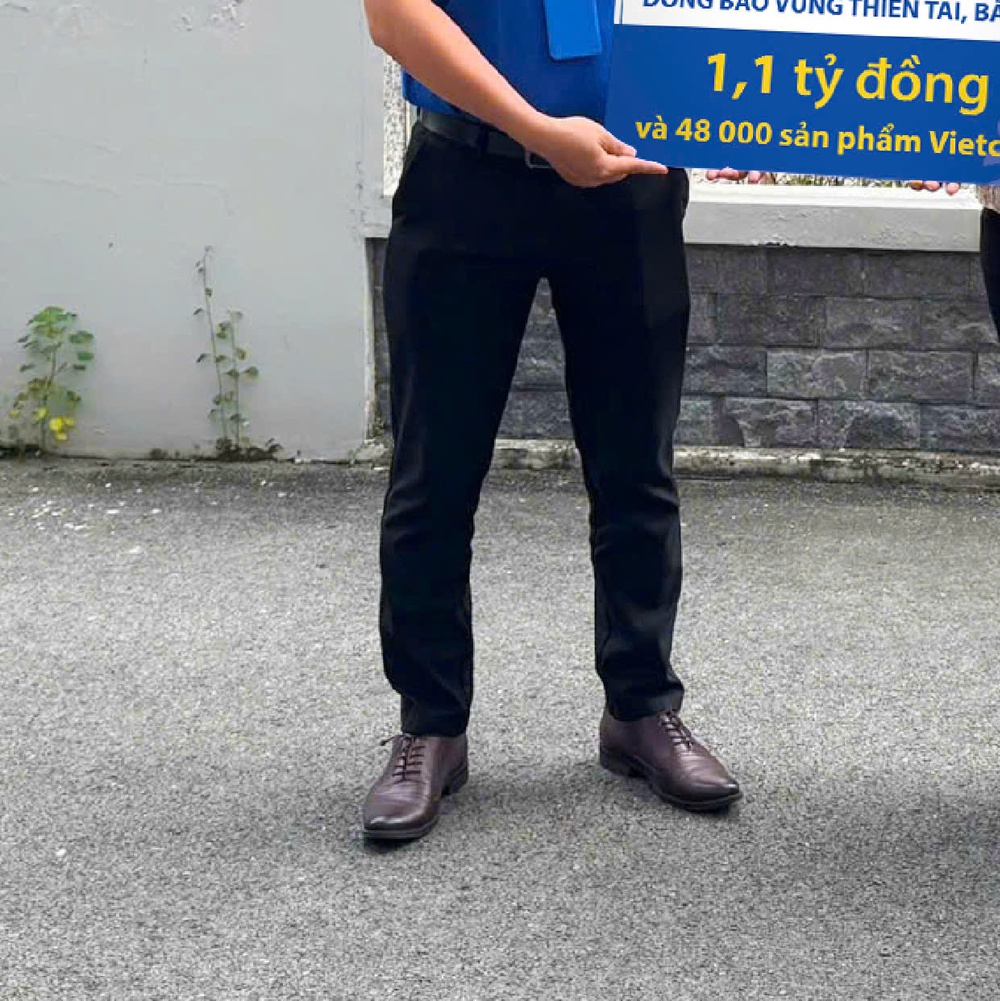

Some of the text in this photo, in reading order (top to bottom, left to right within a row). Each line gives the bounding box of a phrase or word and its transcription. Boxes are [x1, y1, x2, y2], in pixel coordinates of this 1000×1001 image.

[924, 0, 968, 24] TAI,
[707, 53, 990, 116] 1,1 tỷ đồng
[635, 115, 668, 141] và
[675, 118, 711, 143] 48
[719, 120, 773, 146] 000
[779, 121, 829, 149] sản
[837, 123, 922, 157] phẩm
